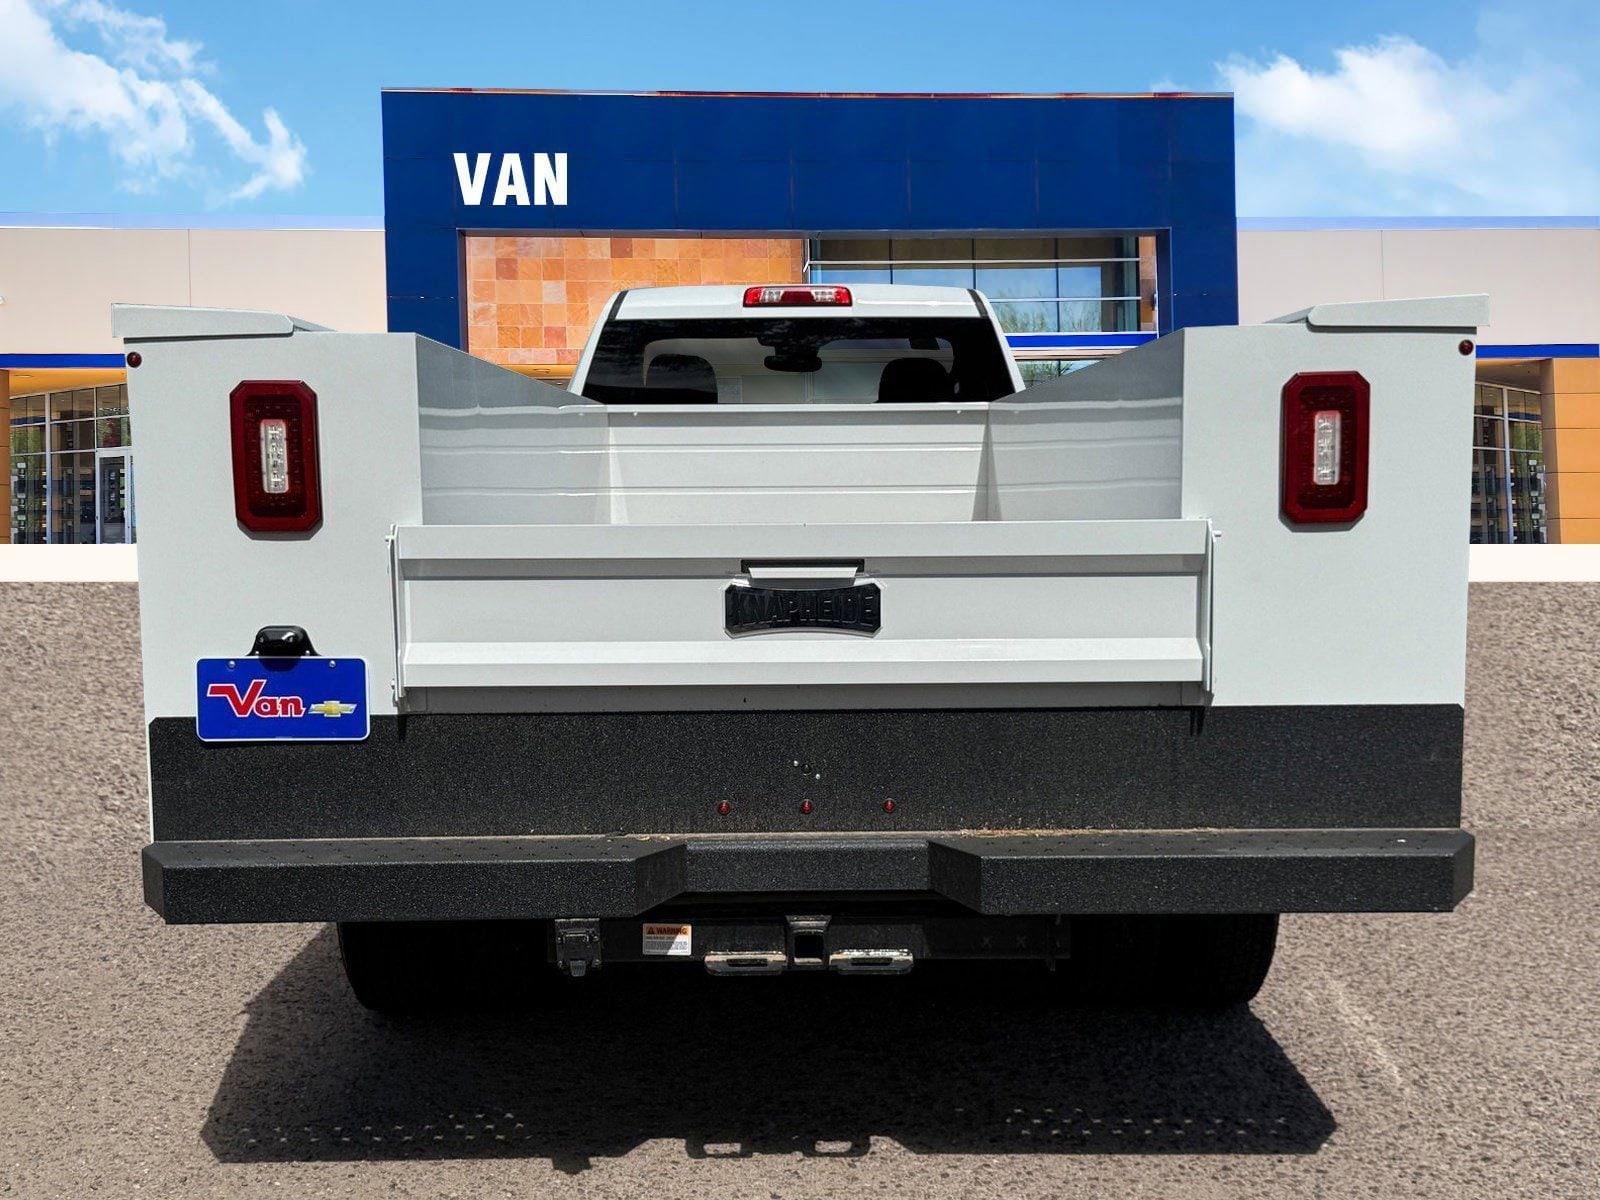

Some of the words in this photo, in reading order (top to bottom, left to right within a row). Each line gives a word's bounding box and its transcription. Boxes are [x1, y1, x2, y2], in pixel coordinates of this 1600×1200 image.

[453, 153, 568, 206] VAN
[207, 679, 306, 718] Van
[656, 926, 689, 935] WARNING
